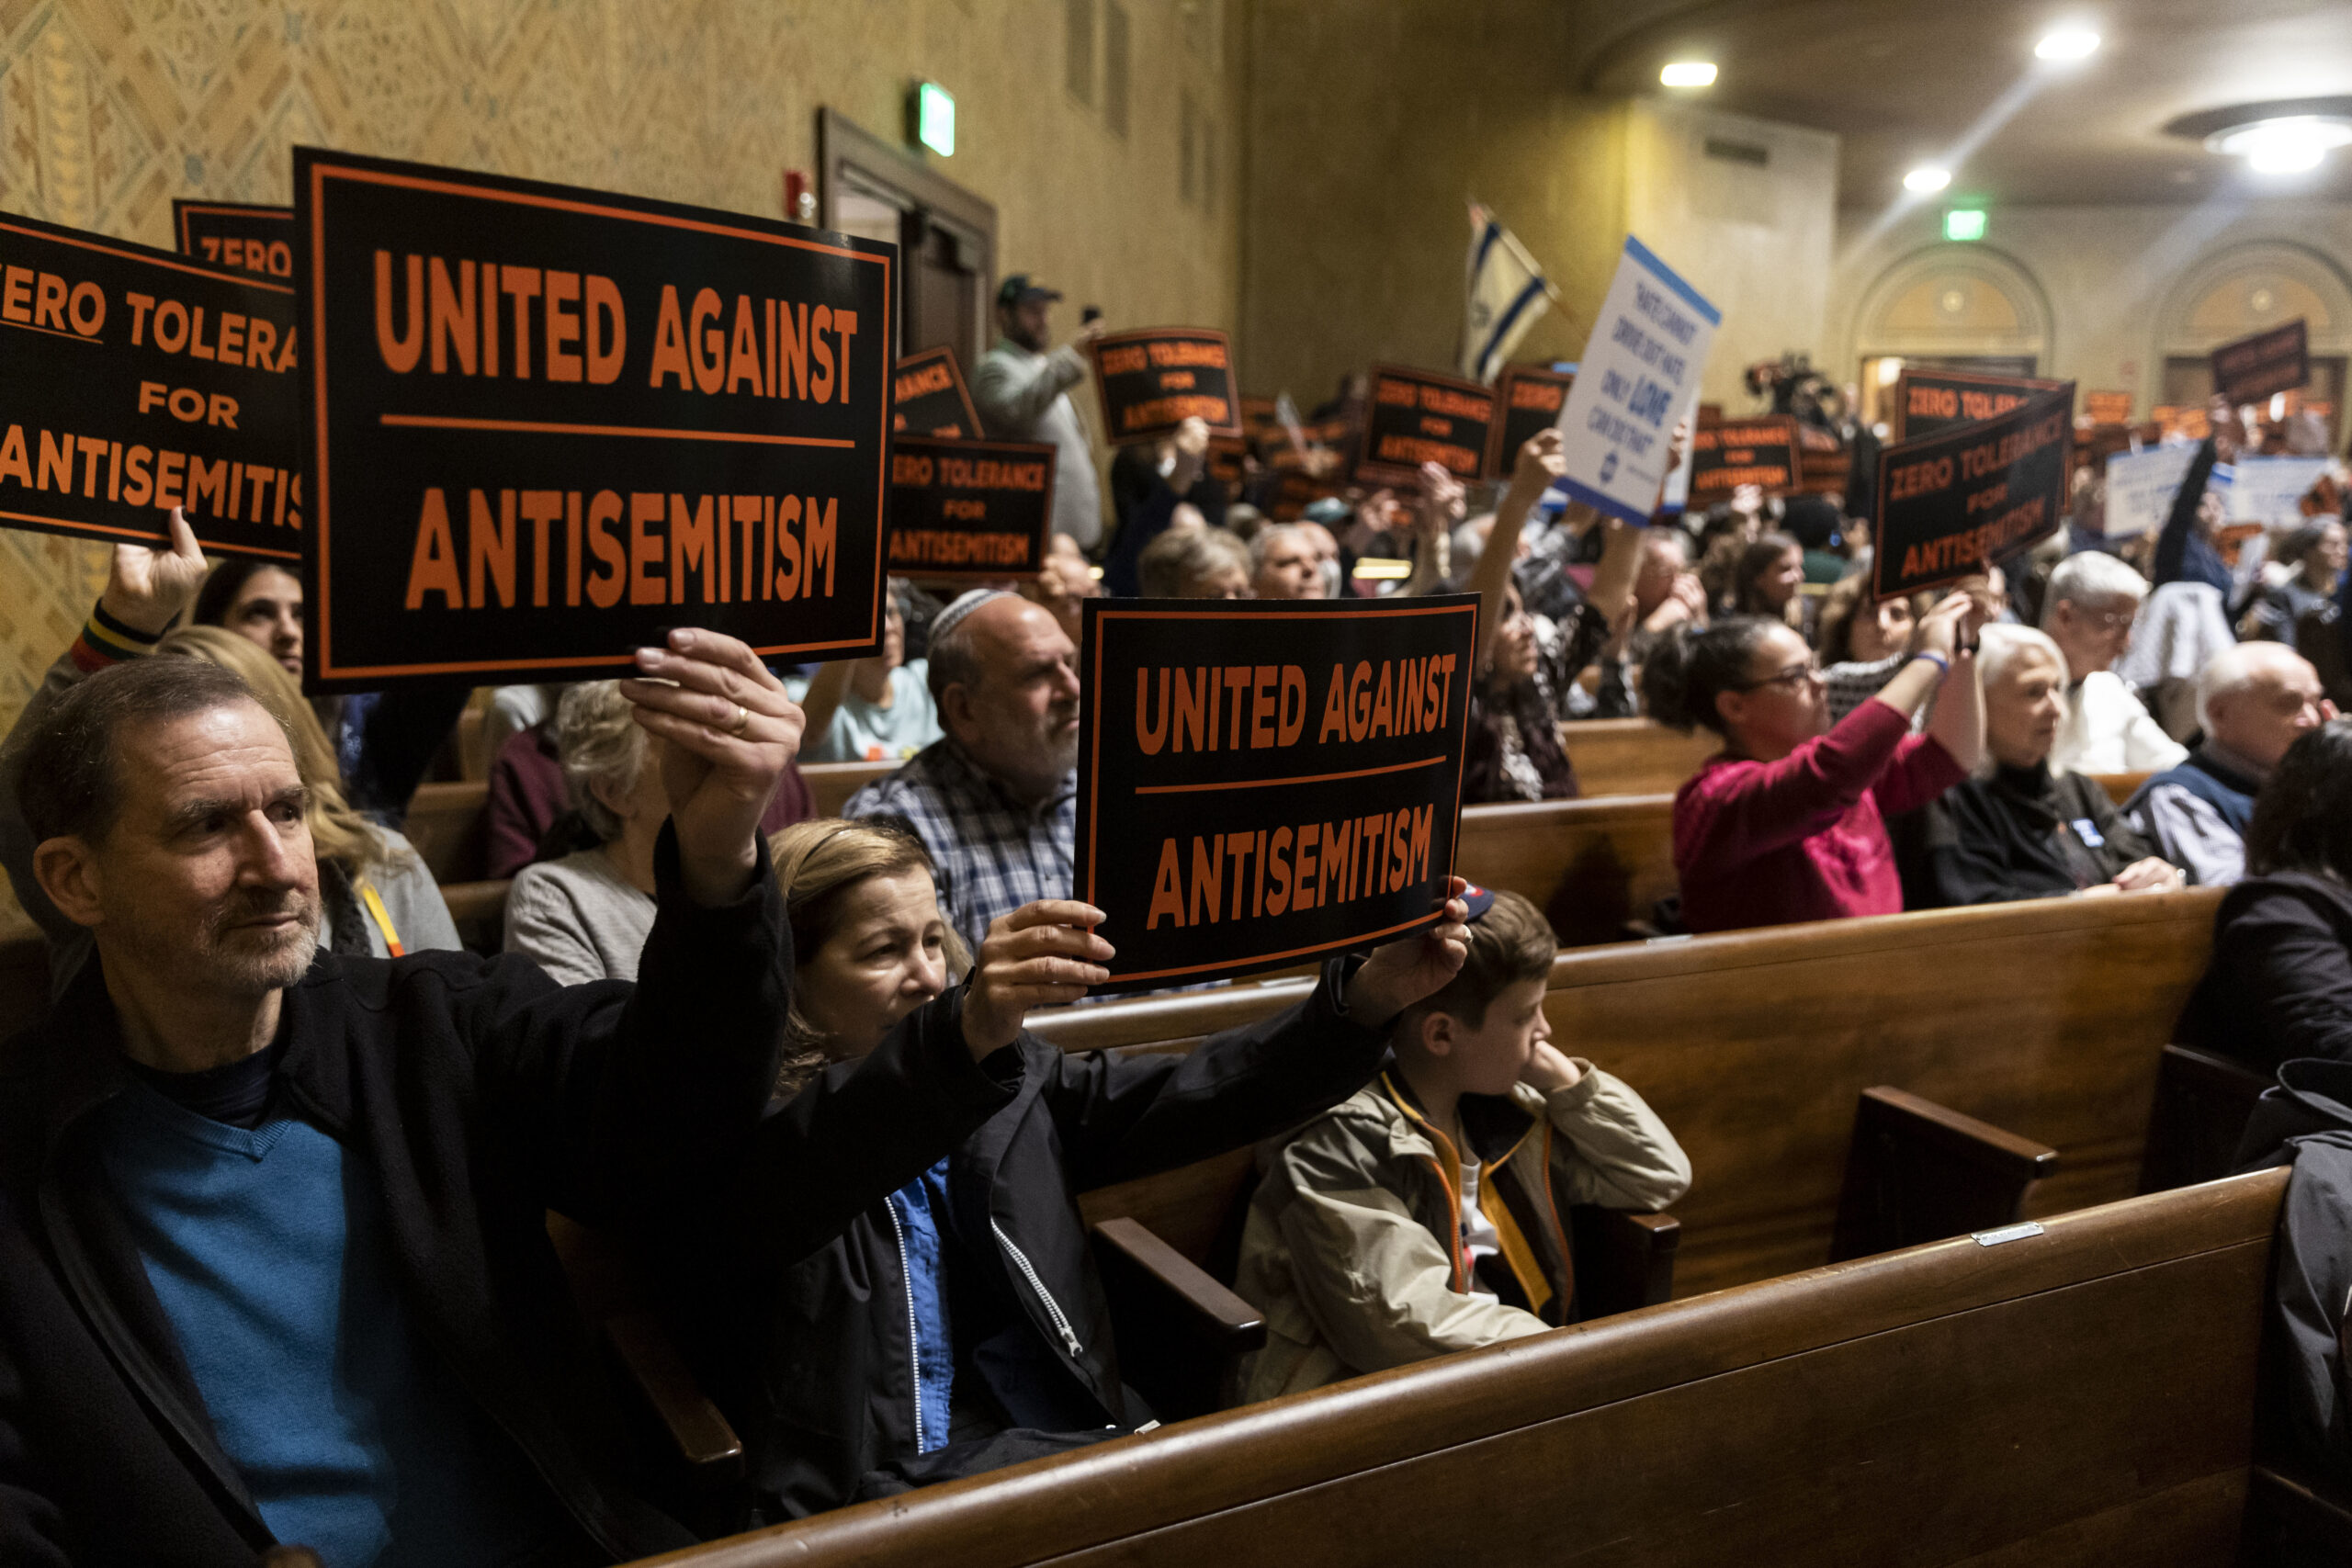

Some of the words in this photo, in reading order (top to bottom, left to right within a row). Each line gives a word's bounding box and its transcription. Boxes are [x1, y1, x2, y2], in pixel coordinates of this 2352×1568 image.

[200, 236, 293, 277] ZERO
[0, 264, 107, 337] ERO
[126, 291, 299, 373] TOLERA
[375, 250, 627, 385] UNITED
[650, 284, 858, 405] AGAINST
[139, 380, 240, 430] FOR
[1907, 386, 1959, 419] ZERO
[0, 424, 302, 530] ANTISEMITI
[892, 454, 933, 486] ERO
[1890, 457, 1955, 501] ZERO
[404, 487, 839, 610] ANTISEMITISM
[1136, 665, 1306, 755] UNITED
[1318, 653, 1456, 744] AGAINST
[1146, 803, 1433, 931] ANTISEMITISM
